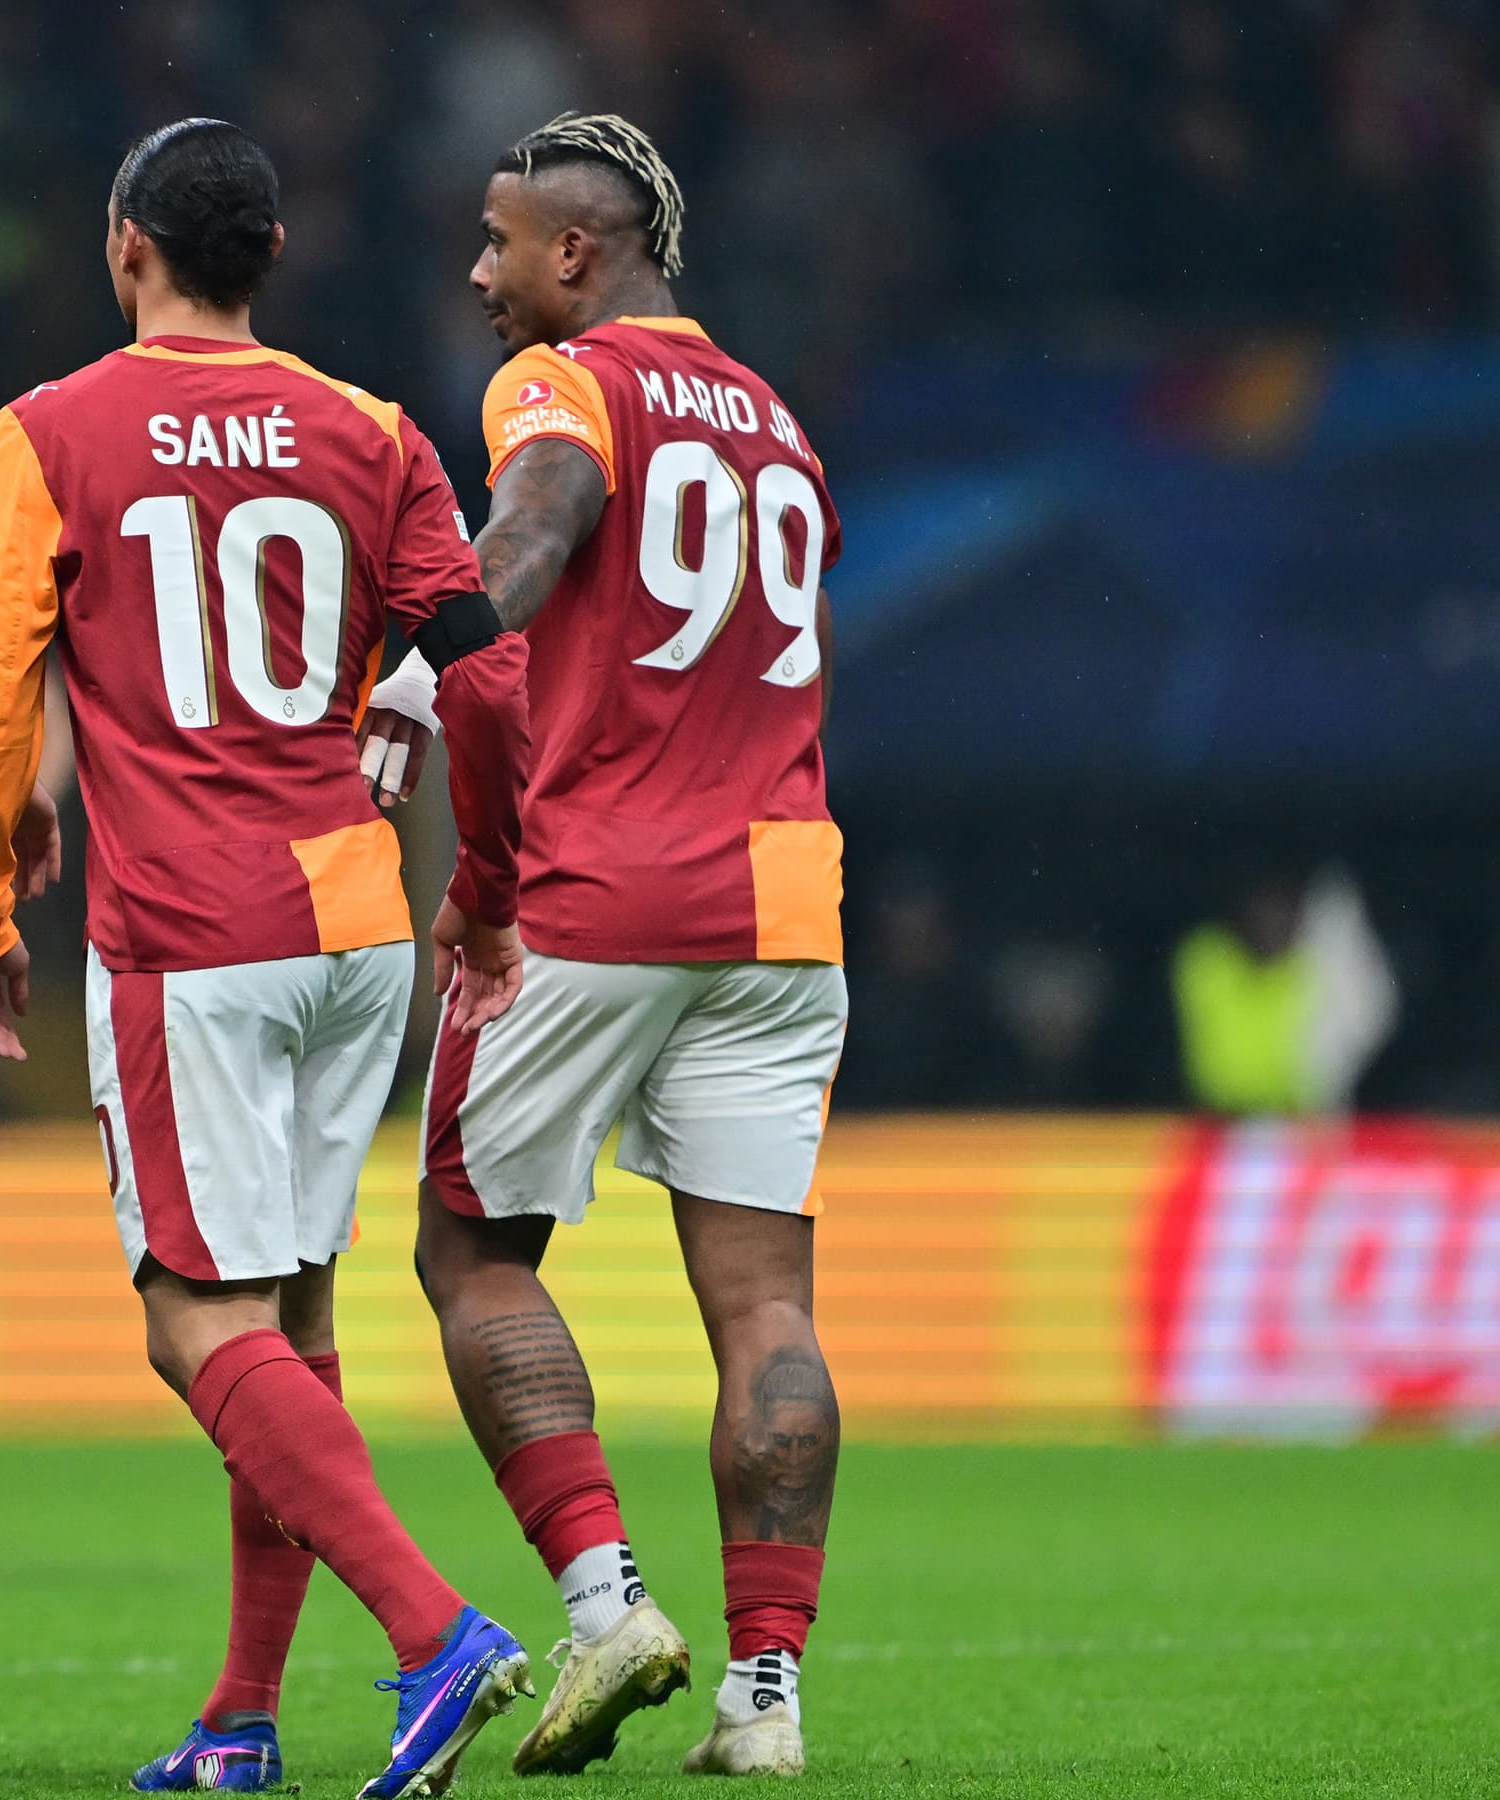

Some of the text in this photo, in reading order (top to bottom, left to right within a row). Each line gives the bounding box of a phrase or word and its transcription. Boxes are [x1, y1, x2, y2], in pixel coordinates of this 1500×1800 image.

[148, 405, 300, 467] SANÉ
[634, 369, 811, 461] MARIO JR.
[632, 441, 825, 687] 99
[121, 496, 351, 728] 10
[571, 1581, 611, 1603] ML99
